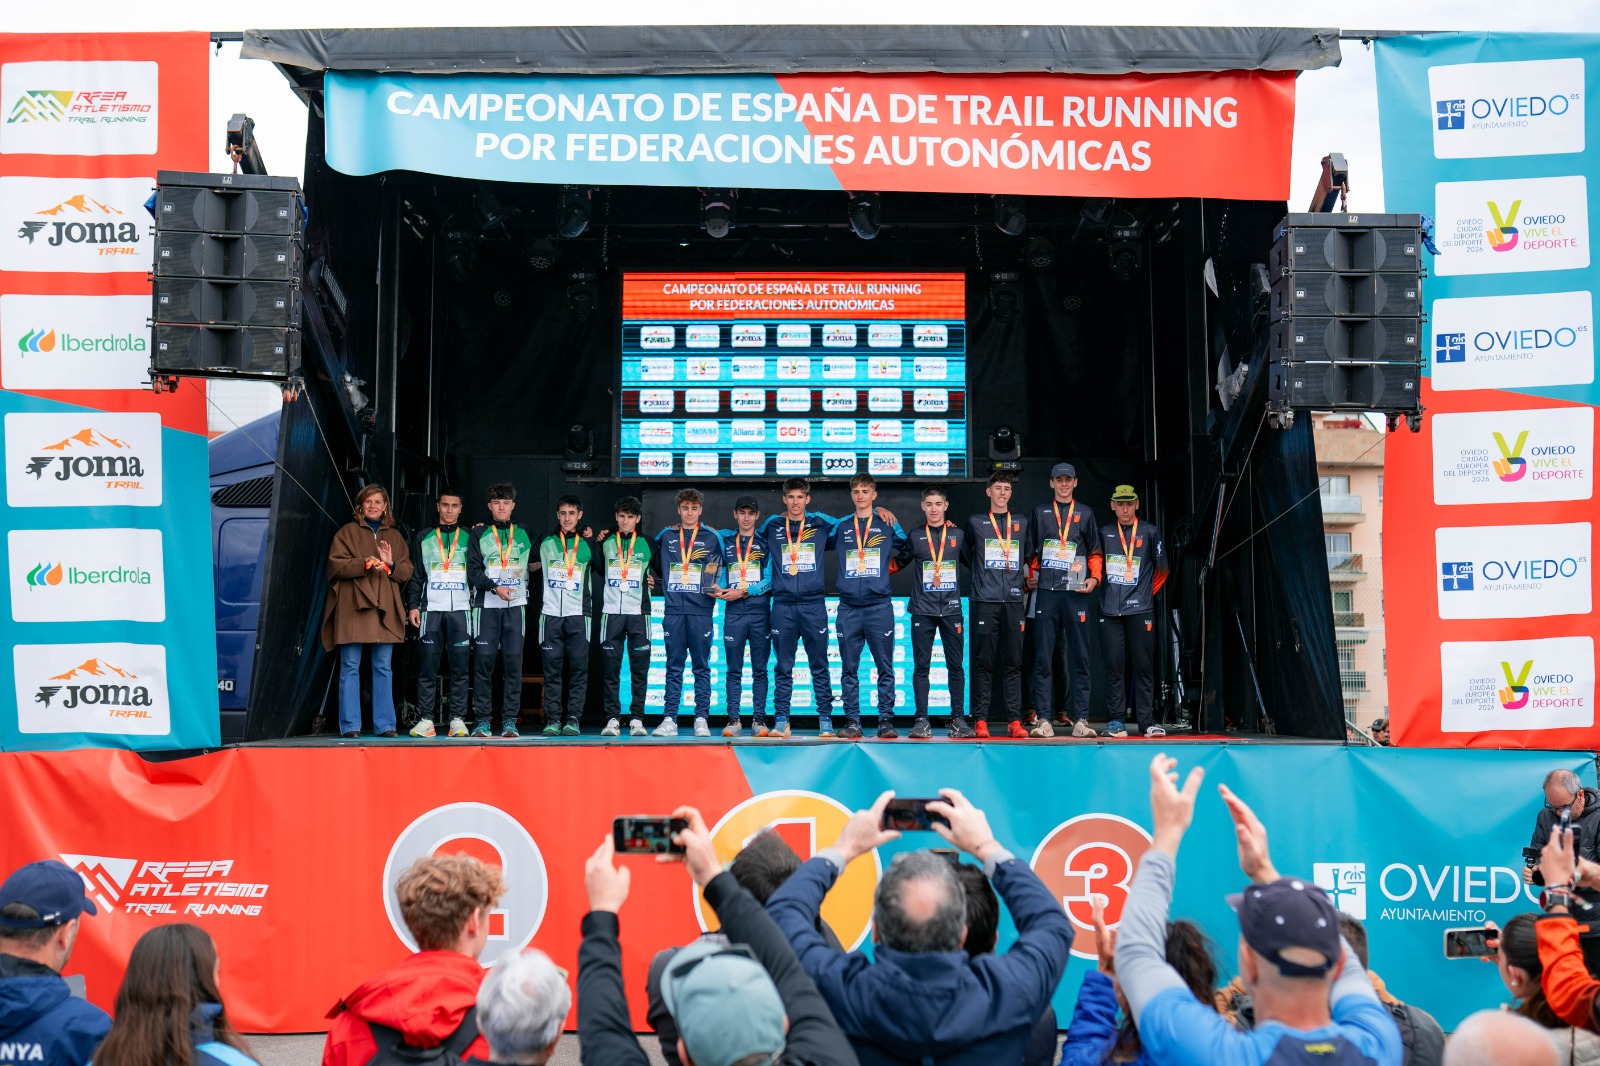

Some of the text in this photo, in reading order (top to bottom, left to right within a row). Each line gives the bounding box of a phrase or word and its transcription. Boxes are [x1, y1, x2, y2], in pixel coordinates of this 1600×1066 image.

[71, 104, 152, 113] ATLETISMO
[387, 86, 1238, 129] CAMPEONATO DE ESPAÑA DE TRAIL RUNNING
[1472, 94, 1569, 119] OVIEDO
[68, 116, 97, 125] TRAIL
[1472, 120, 1528, 129] AYUNTAMIENTO
[474, 132, 1152, 172] POR FEDERACIONES AUTONÓMICAS
[1523, 215, 1566, 225] OVIEDO
[48, 221, 140, 246] Joma
[1523, 227, 1563, 237] VIVE EL
[1523, 238, 1578, 250] DEPORTE
[663, 281, 922, 295] CAMPEONATO DE ESPAÑA DE TRAIL RUNNING
[690, 297, 895, 311] POR FEDERACIONES AUTONÓMICAS
[61, 333, 146, 352] Iberdrola
[1474, 327, 1576, 352] OVIEDO
[1475, 352, 1534, 362] AYUNTAMIENTO
[733, 428, 755, 436] Allianz
[780, 427, 796, 436] GO
[1531, 445, 1575, 456] OVIEDO
[55, 456, 144, 481] Joma
[1531, 458, 1573, 467] VIVE EL
[1532, 469, 1584, 480] DEPORTE
[105, 481, 144, 489] TRAIL
[68, 566, 151, 585] Iberdrola
[1482, 558, 1577, 581] OVIEDO
[1483, 582, 1542, 591] AYUNTAMIENTO
[1533, 674, 1573, 684] OVIEDO
[218, 680, 233, 691] 40
[1533, 687, 1571, 696] VIVE EL
[63, 684, 153, 709] Joma
[1533, 697, 1583, 709] DEPORTE
[109, 709, 152, 718] TRAIL
[137, 859, 234, 883] RFEA
[130, 882, 269, 899] ATLETISMO
[1064, 841, 1134, 932] 3
[124, 902, 262, 917] TRAIL RUNNING
[1380, 908, 1486, 922] AYUNTAMIENTO
